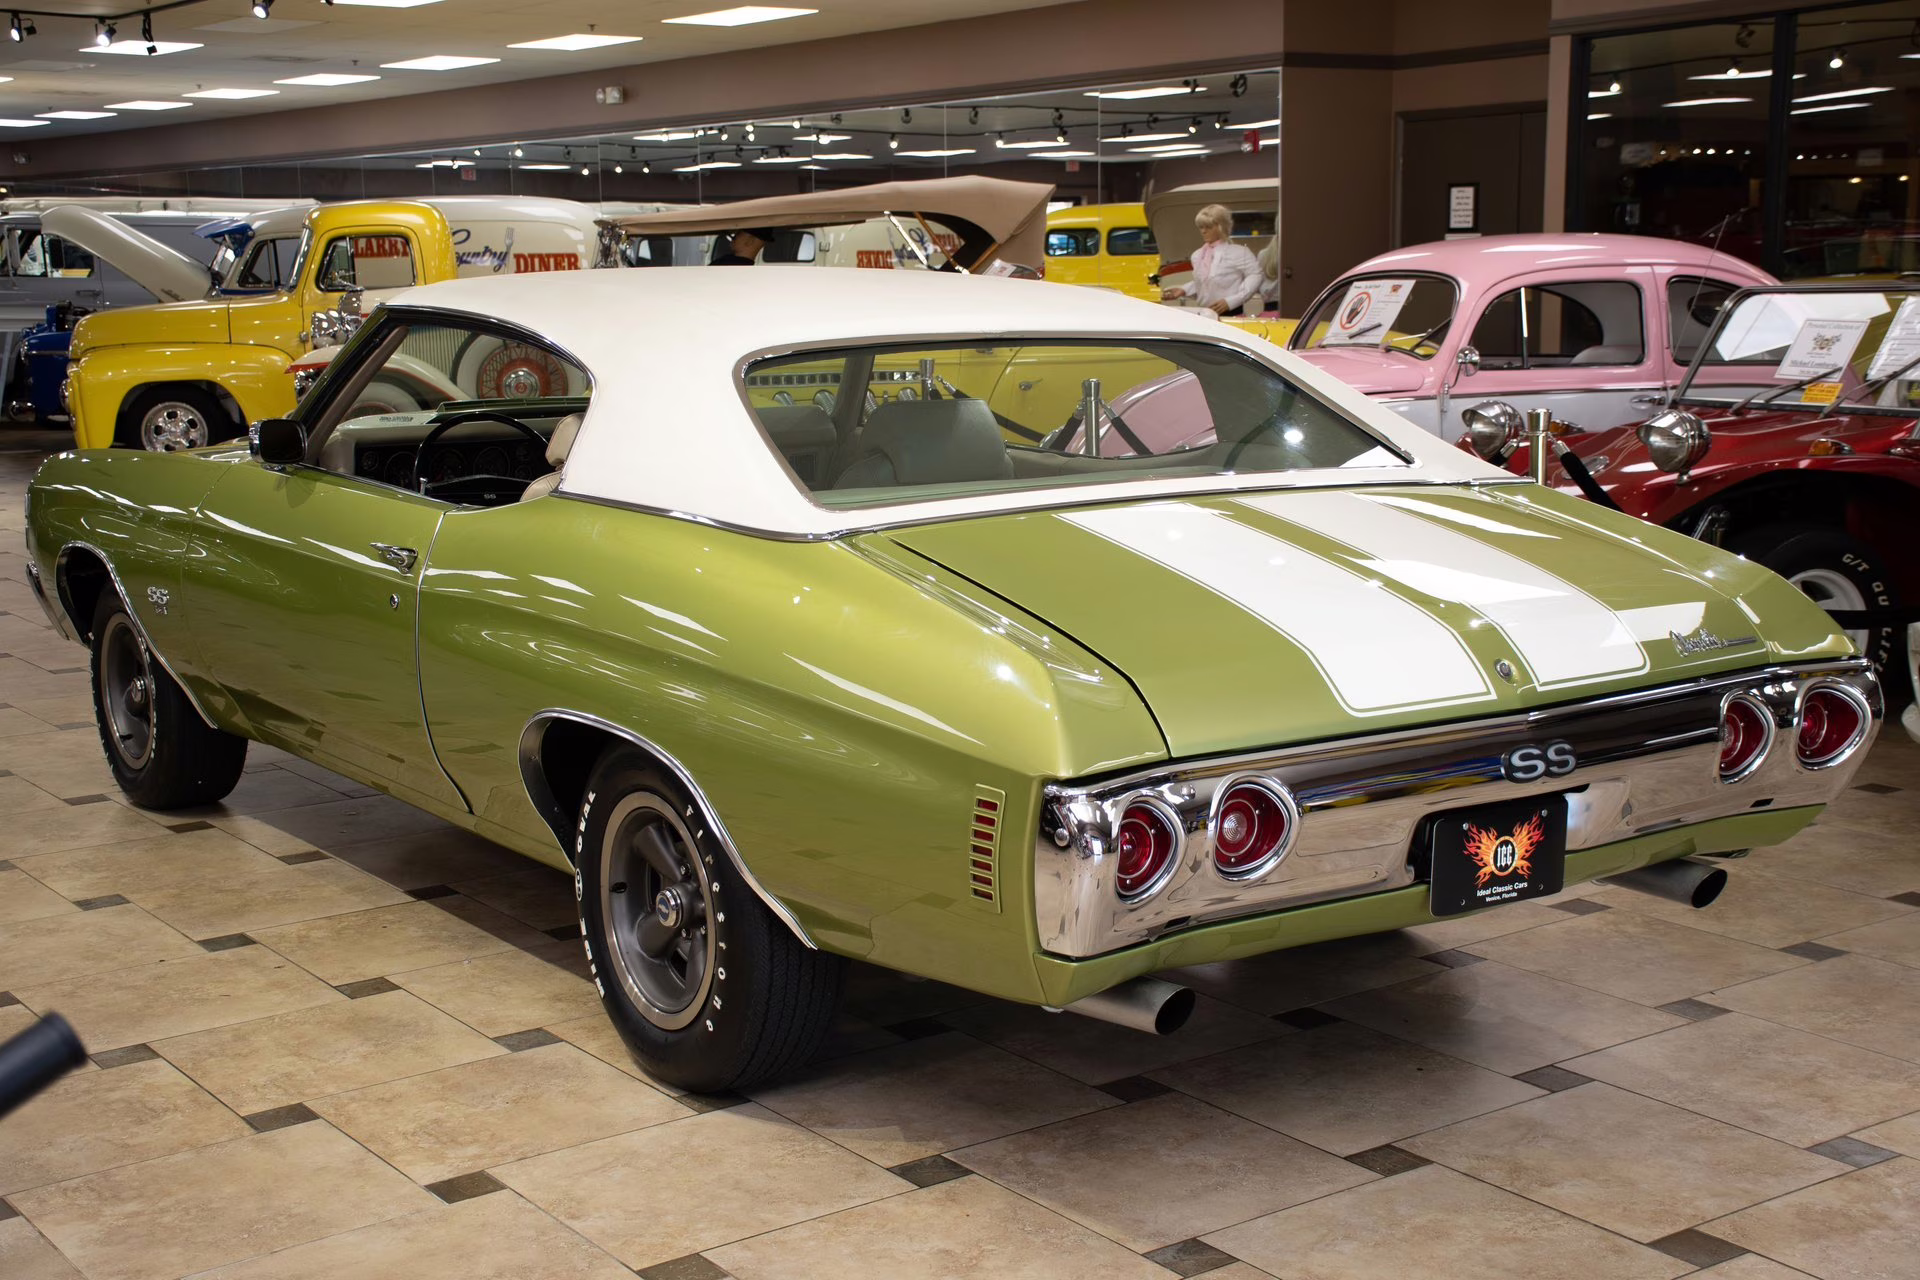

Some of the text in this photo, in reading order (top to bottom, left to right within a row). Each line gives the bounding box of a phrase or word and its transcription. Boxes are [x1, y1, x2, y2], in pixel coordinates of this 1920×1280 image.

[513, 253, 581, 273] DINER
[147, 586, 170, 604] SS
[1508, 742, 1577, 780] SS
[577, 790, 597, 853] OVAL
[1497, 844, 1512, 867] ICC
[1477, 888, 1491, 896] Ideal
[1492, 884, 1513, 893] Classic
